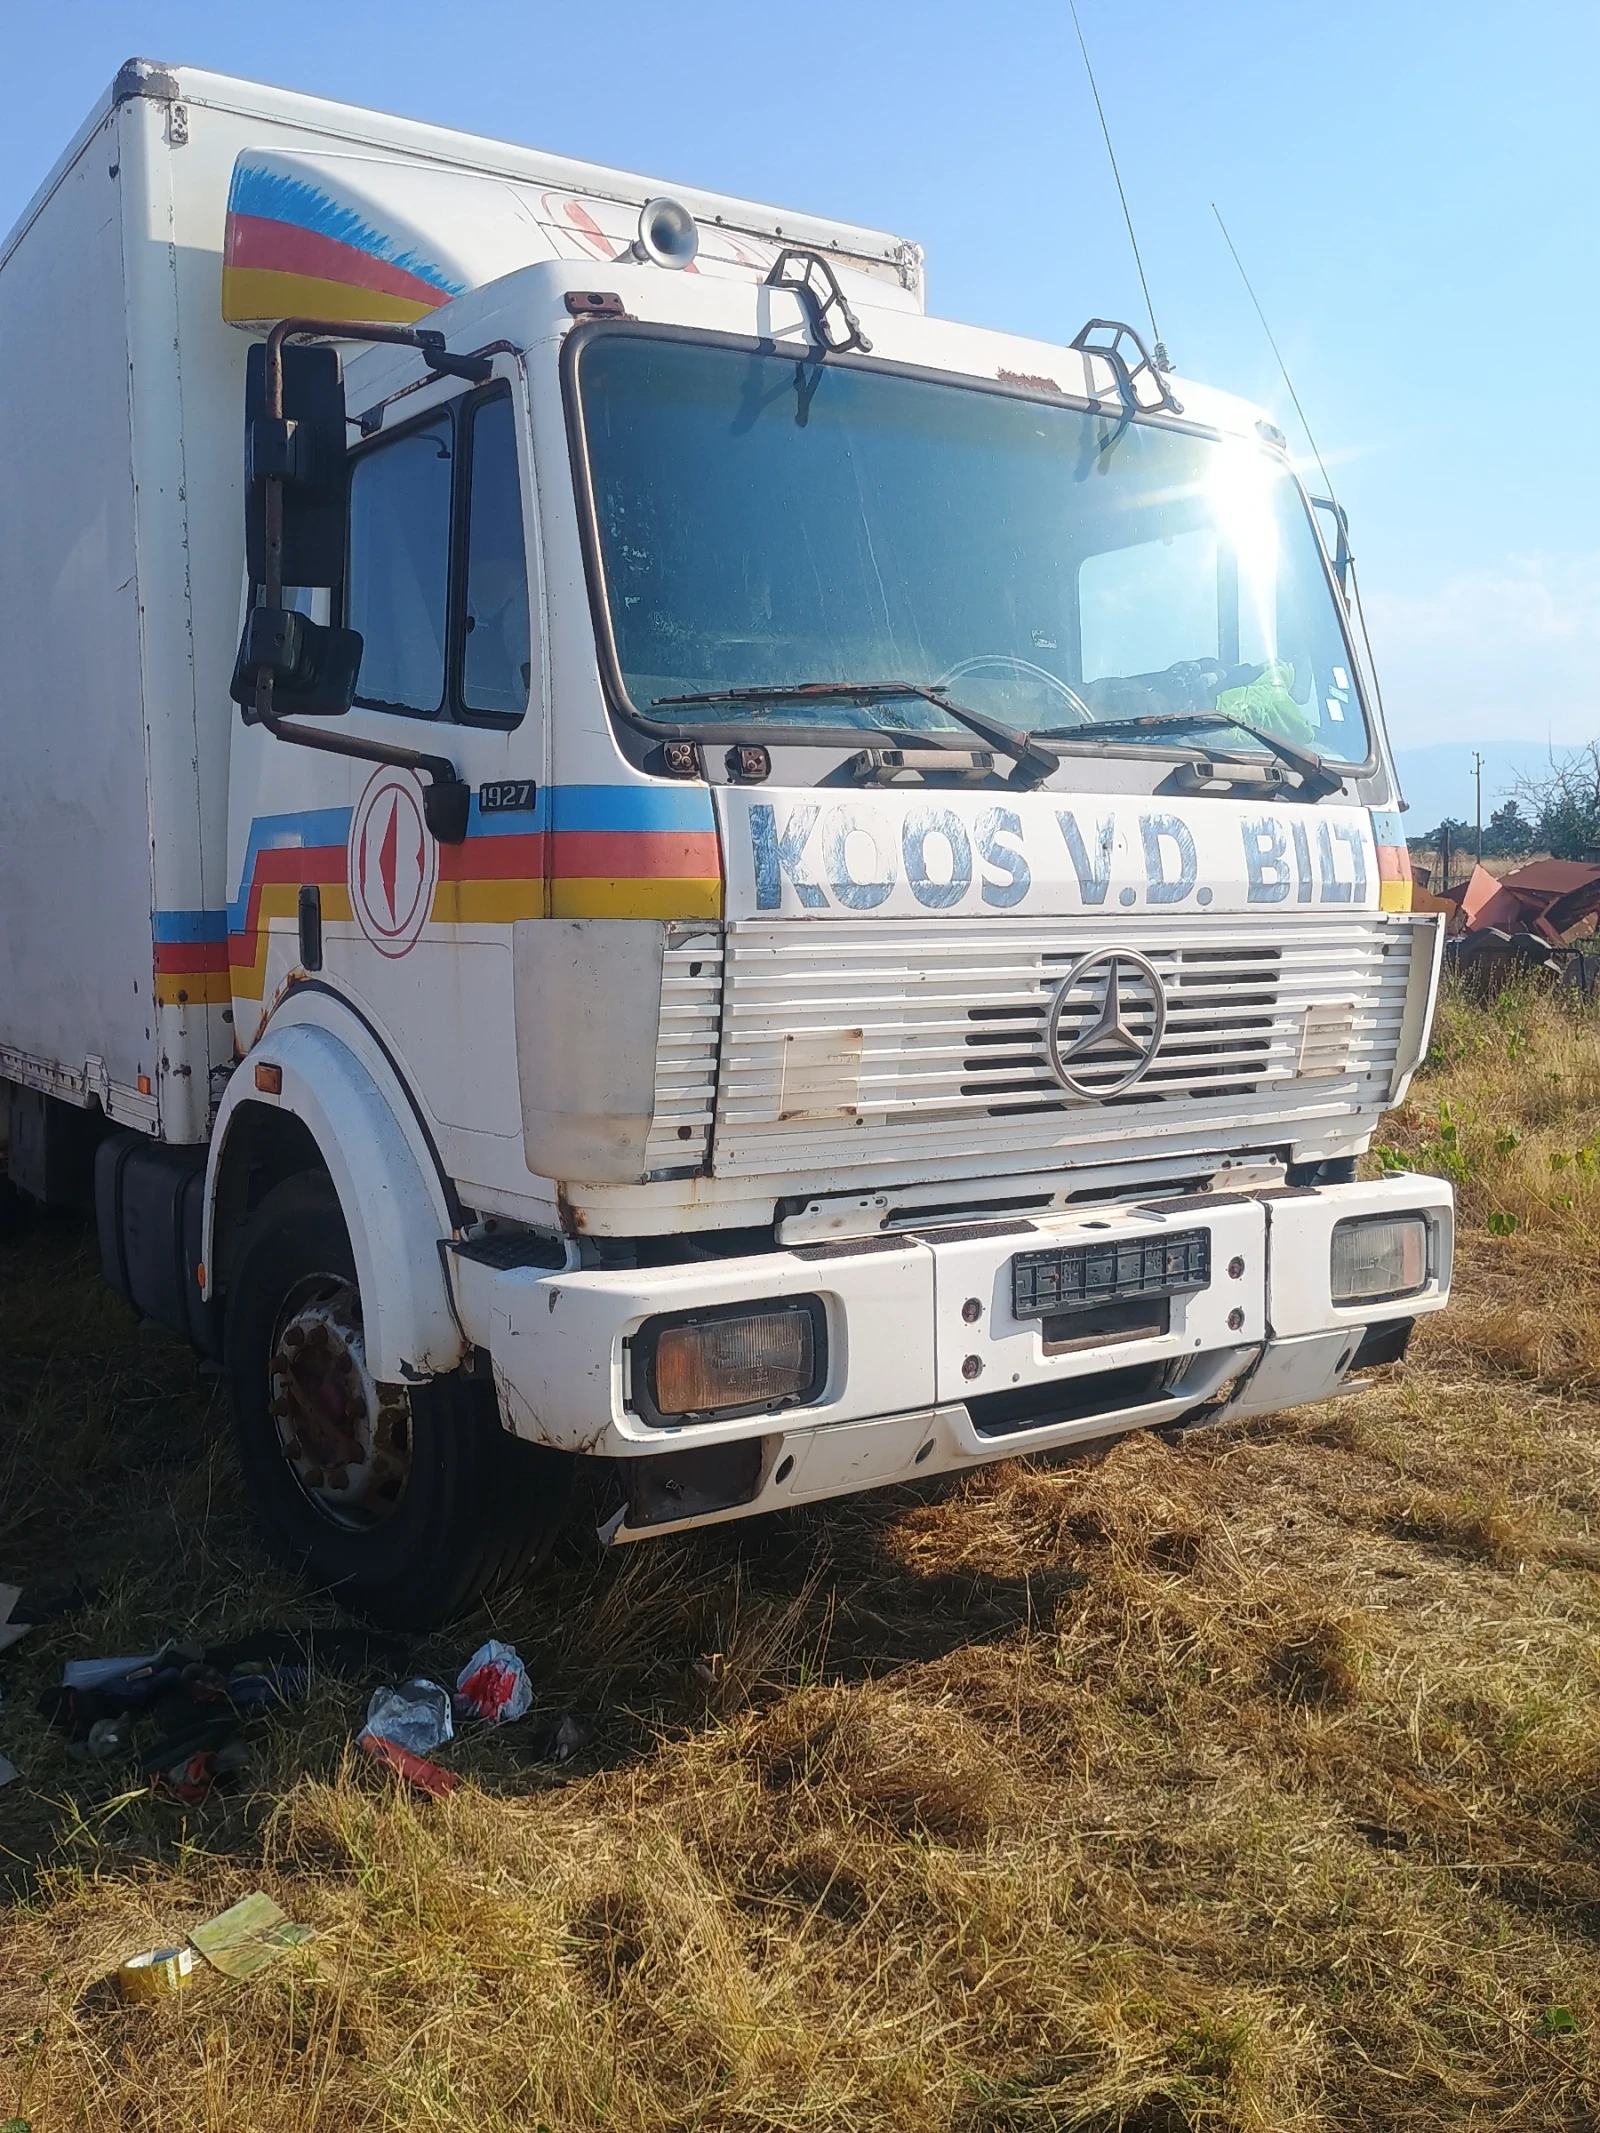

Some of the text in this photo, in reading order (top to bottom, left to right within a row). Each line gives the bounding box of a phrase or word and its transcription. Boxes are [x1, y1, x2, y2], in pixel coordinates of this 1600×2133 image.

[481, 785, 530, 807] 1927
[748, 803, 1367, 910] KOOS V.D. BILT
